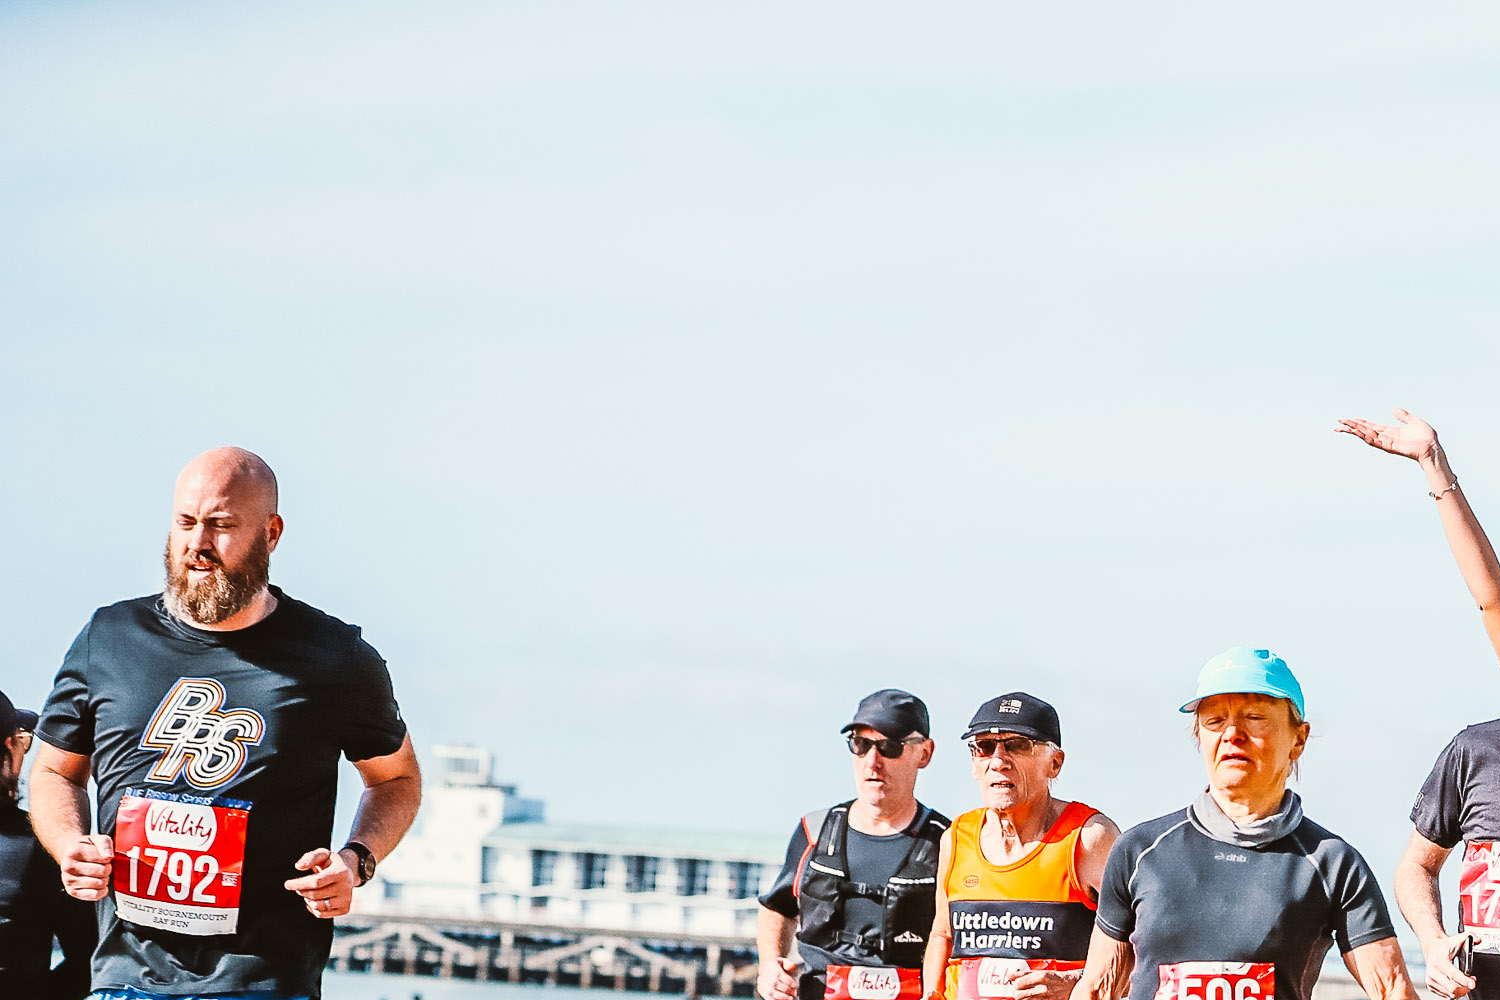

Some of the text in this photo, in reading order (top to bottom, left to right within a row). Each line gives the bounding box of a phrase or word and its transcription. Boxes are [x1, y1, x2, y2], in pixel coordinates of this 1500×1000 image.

[150, 806, 213, 846] Vitality
[126, 845, 219, 904] 1792
[952, 911, 1055, 931] Littledown
[960, 931, 1042, 950] Harriers
